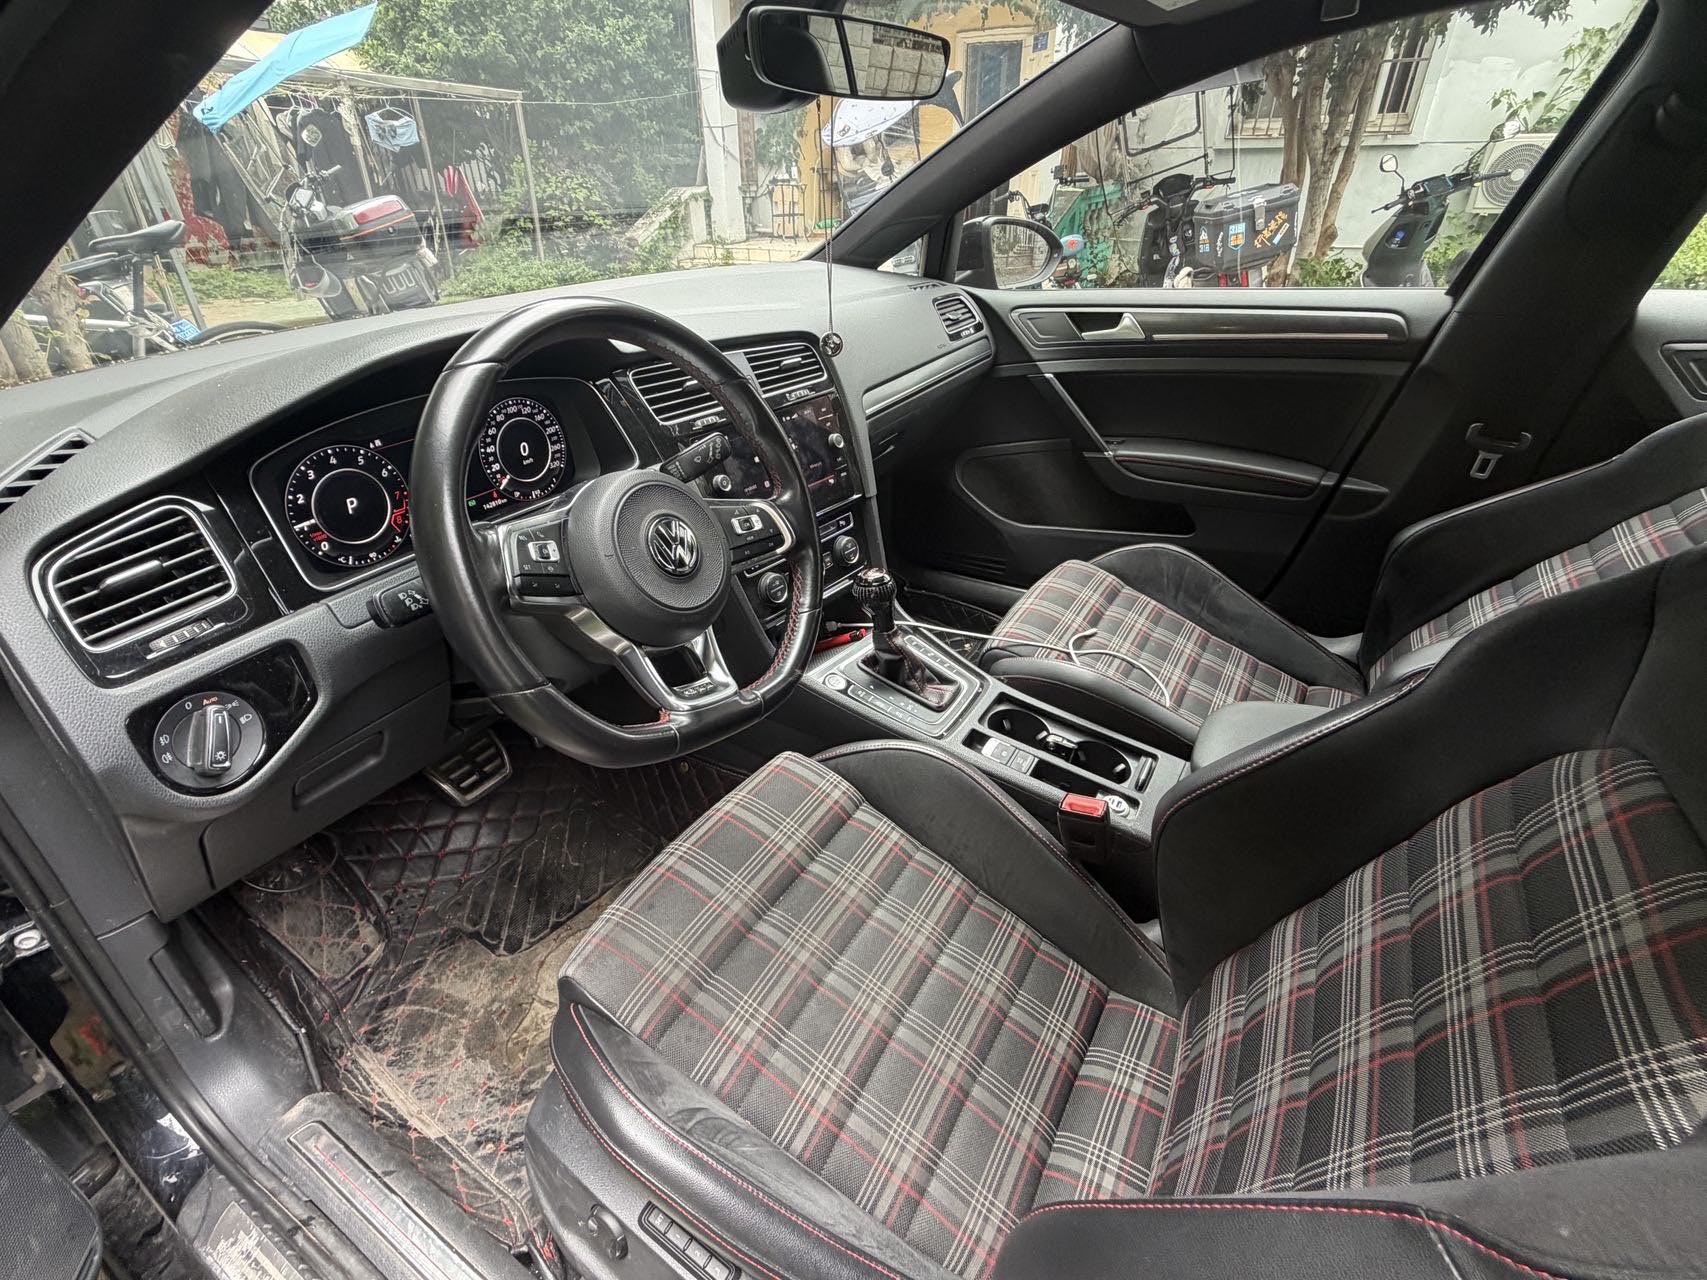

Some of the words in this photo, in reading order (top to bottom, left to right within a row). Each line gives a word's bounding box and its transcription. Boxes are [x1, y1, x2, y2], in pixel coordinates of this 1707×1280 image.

[506, 405, 518, 414] 100
[521, 406, 531, 415] 120
[534, 413, 545, 422] 160
[488, 427, 496, 436] 60
[546, 426, 556, 435] 200
[486, 445, 495, 453] 40
[520, 442, 529, 456] 0
[551, 443, 560, 452] 260
[329, 455, 337, 465] 4
[357, 455, 365, 465] 5
[550, 460, 560, 469] 320
[491, 463, 500, 471] 20
[306, 469, 315, 480] 3
[381, 468, 388, 478] 6
[296, 494, 305, 504] 2
[394, 490, 400, 500] 7
[346, 497, 358, 515] P
[396, 515, 403, 524] 8
[320, 541, 329, 551] 0
